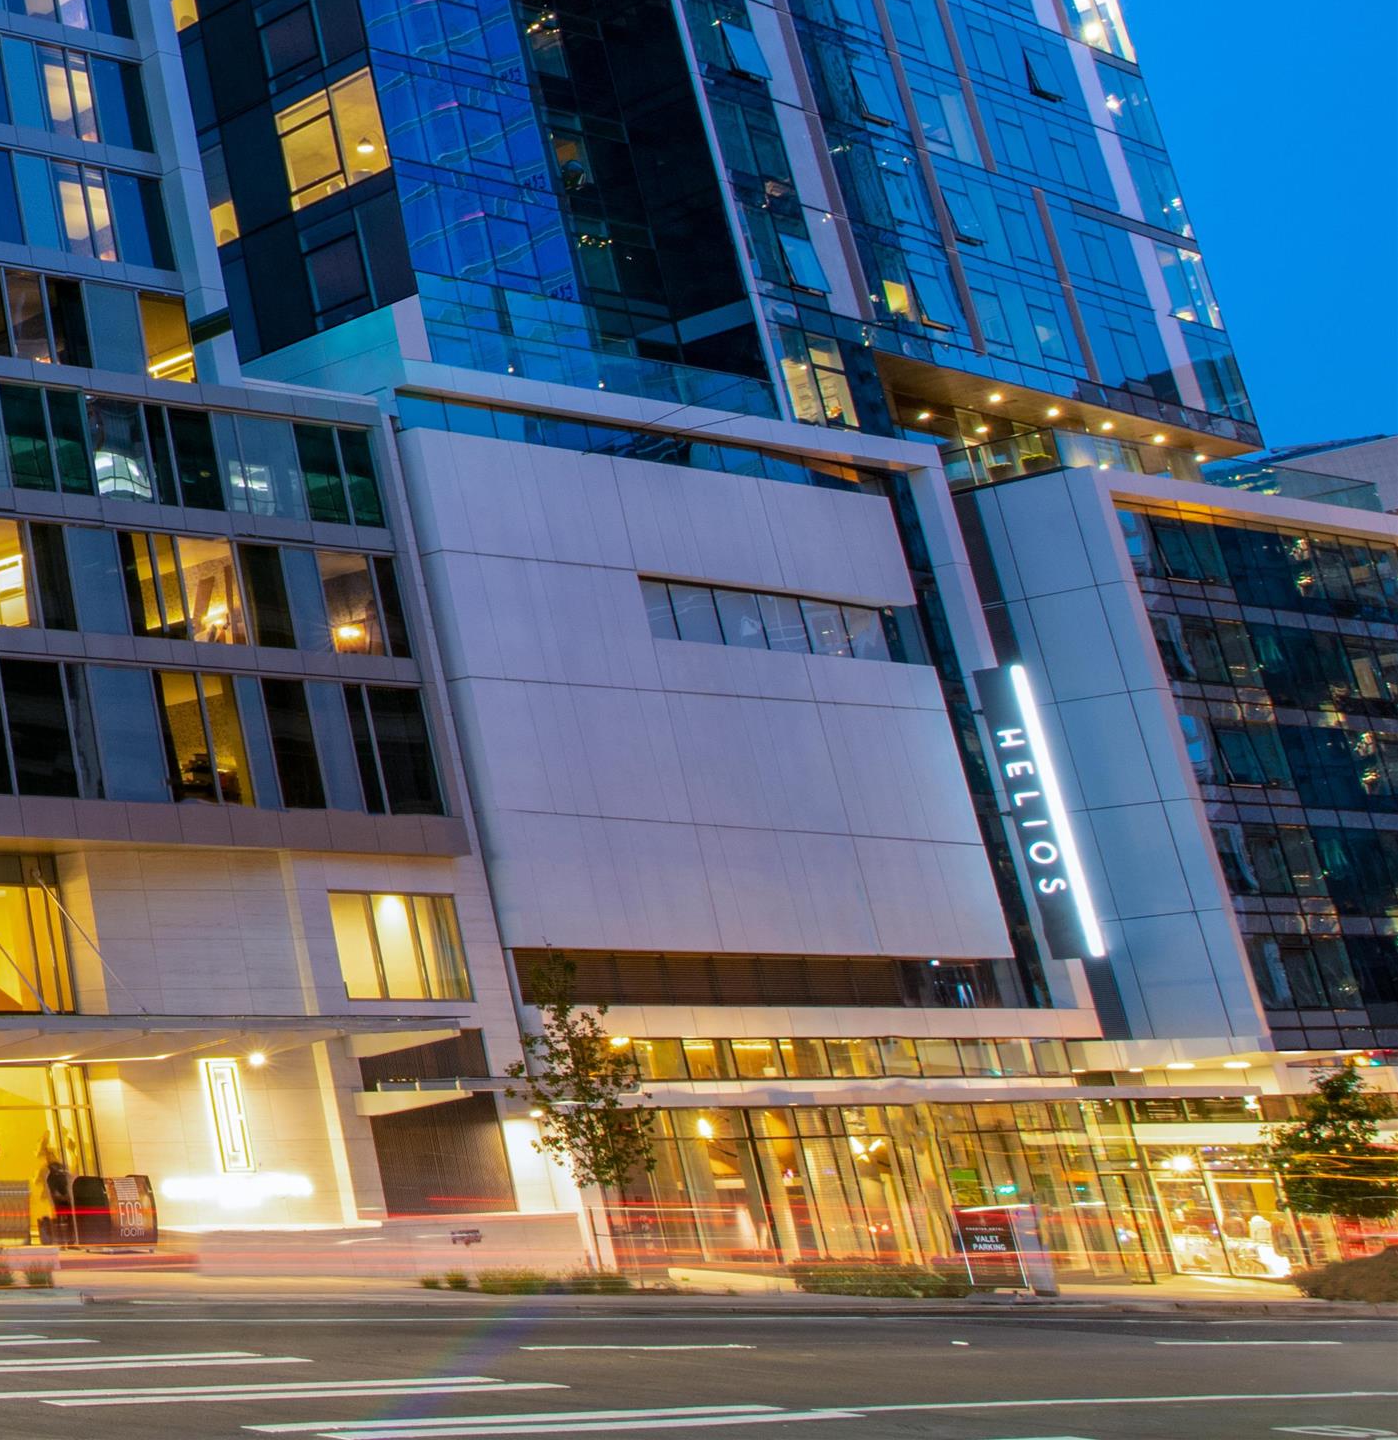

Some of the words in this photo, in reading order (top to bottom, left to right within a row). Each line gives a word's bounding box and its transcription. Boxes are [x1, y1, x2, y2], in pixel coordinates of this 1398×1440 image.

[996, 727, 1067, 894] HELIOS
[118, 1201, 143, 1226] FOG
[120, 1228, 145, 1237] room
[974, 1235, 999, 1243] VALET
[972, 1243, 1006, 1251] PARKING
